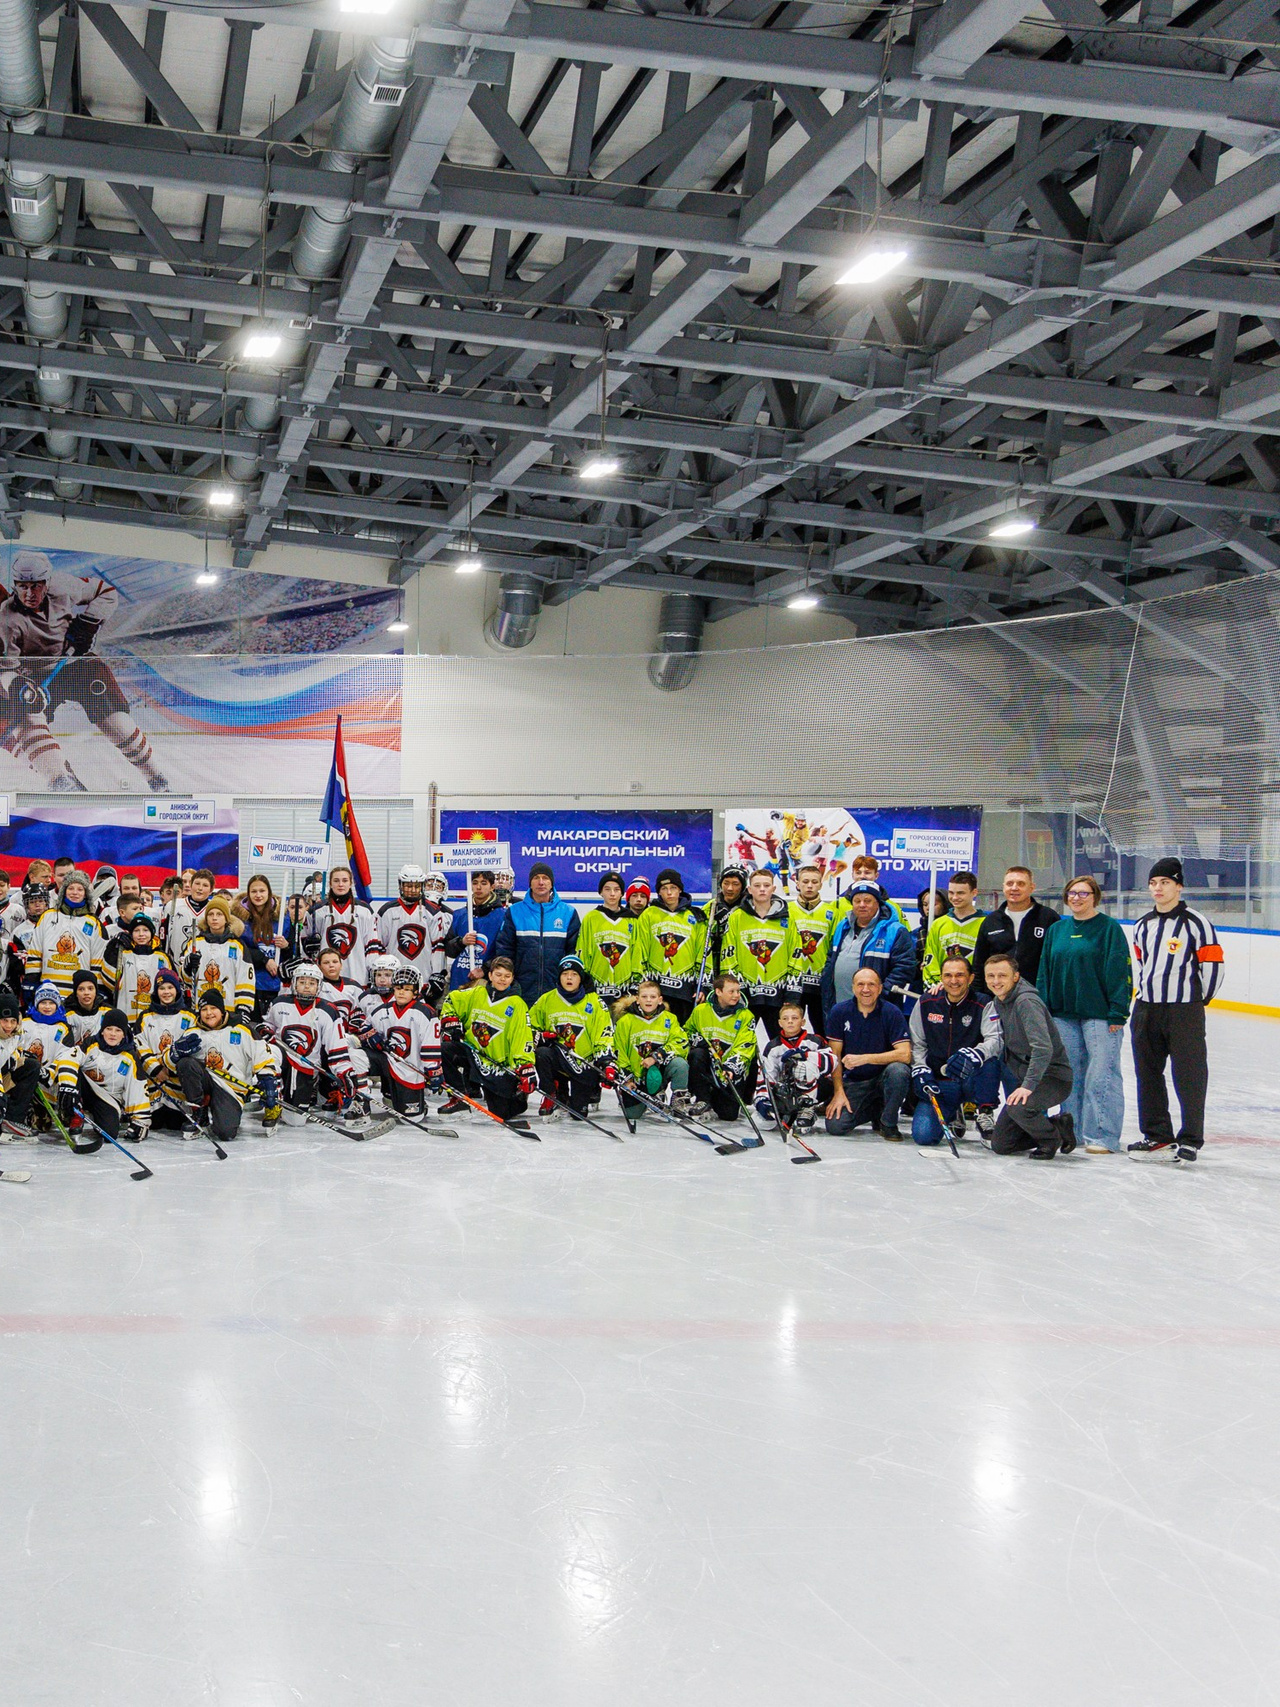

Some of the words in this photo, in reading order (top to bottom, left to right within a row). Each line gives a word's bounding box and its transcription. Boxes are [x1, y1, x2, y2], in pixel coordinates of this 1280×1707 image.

[170, 802, 199, 811] АНИВСКИЙ
[159, 812, 191, 821] ГОРОДСКОЙ
[537, 828, 669, 841] МАКАРОВСКИЙ
[267, 842, 303, 854] ГОРОДСКОЙ
[304, 846, 324, 855] ОКРУГ
[452, 846, 497, 857] МАКАРОВСКИЙ
[521, 844, 685, 857] МУНИЦИПАЛЬНЫЙ
[270, 853, 319, 866] «НОГЛИКСКИЙ»
[446, 856, 482, 867] ГОРОДСКОЙ
[483, 857, 502, 866] ОКРУГ
[574, 862, 632, 873] ОКРУГ
[458, 957, 483, 965] ЕДИАЯ
[247, 966, 254, 980] 6
